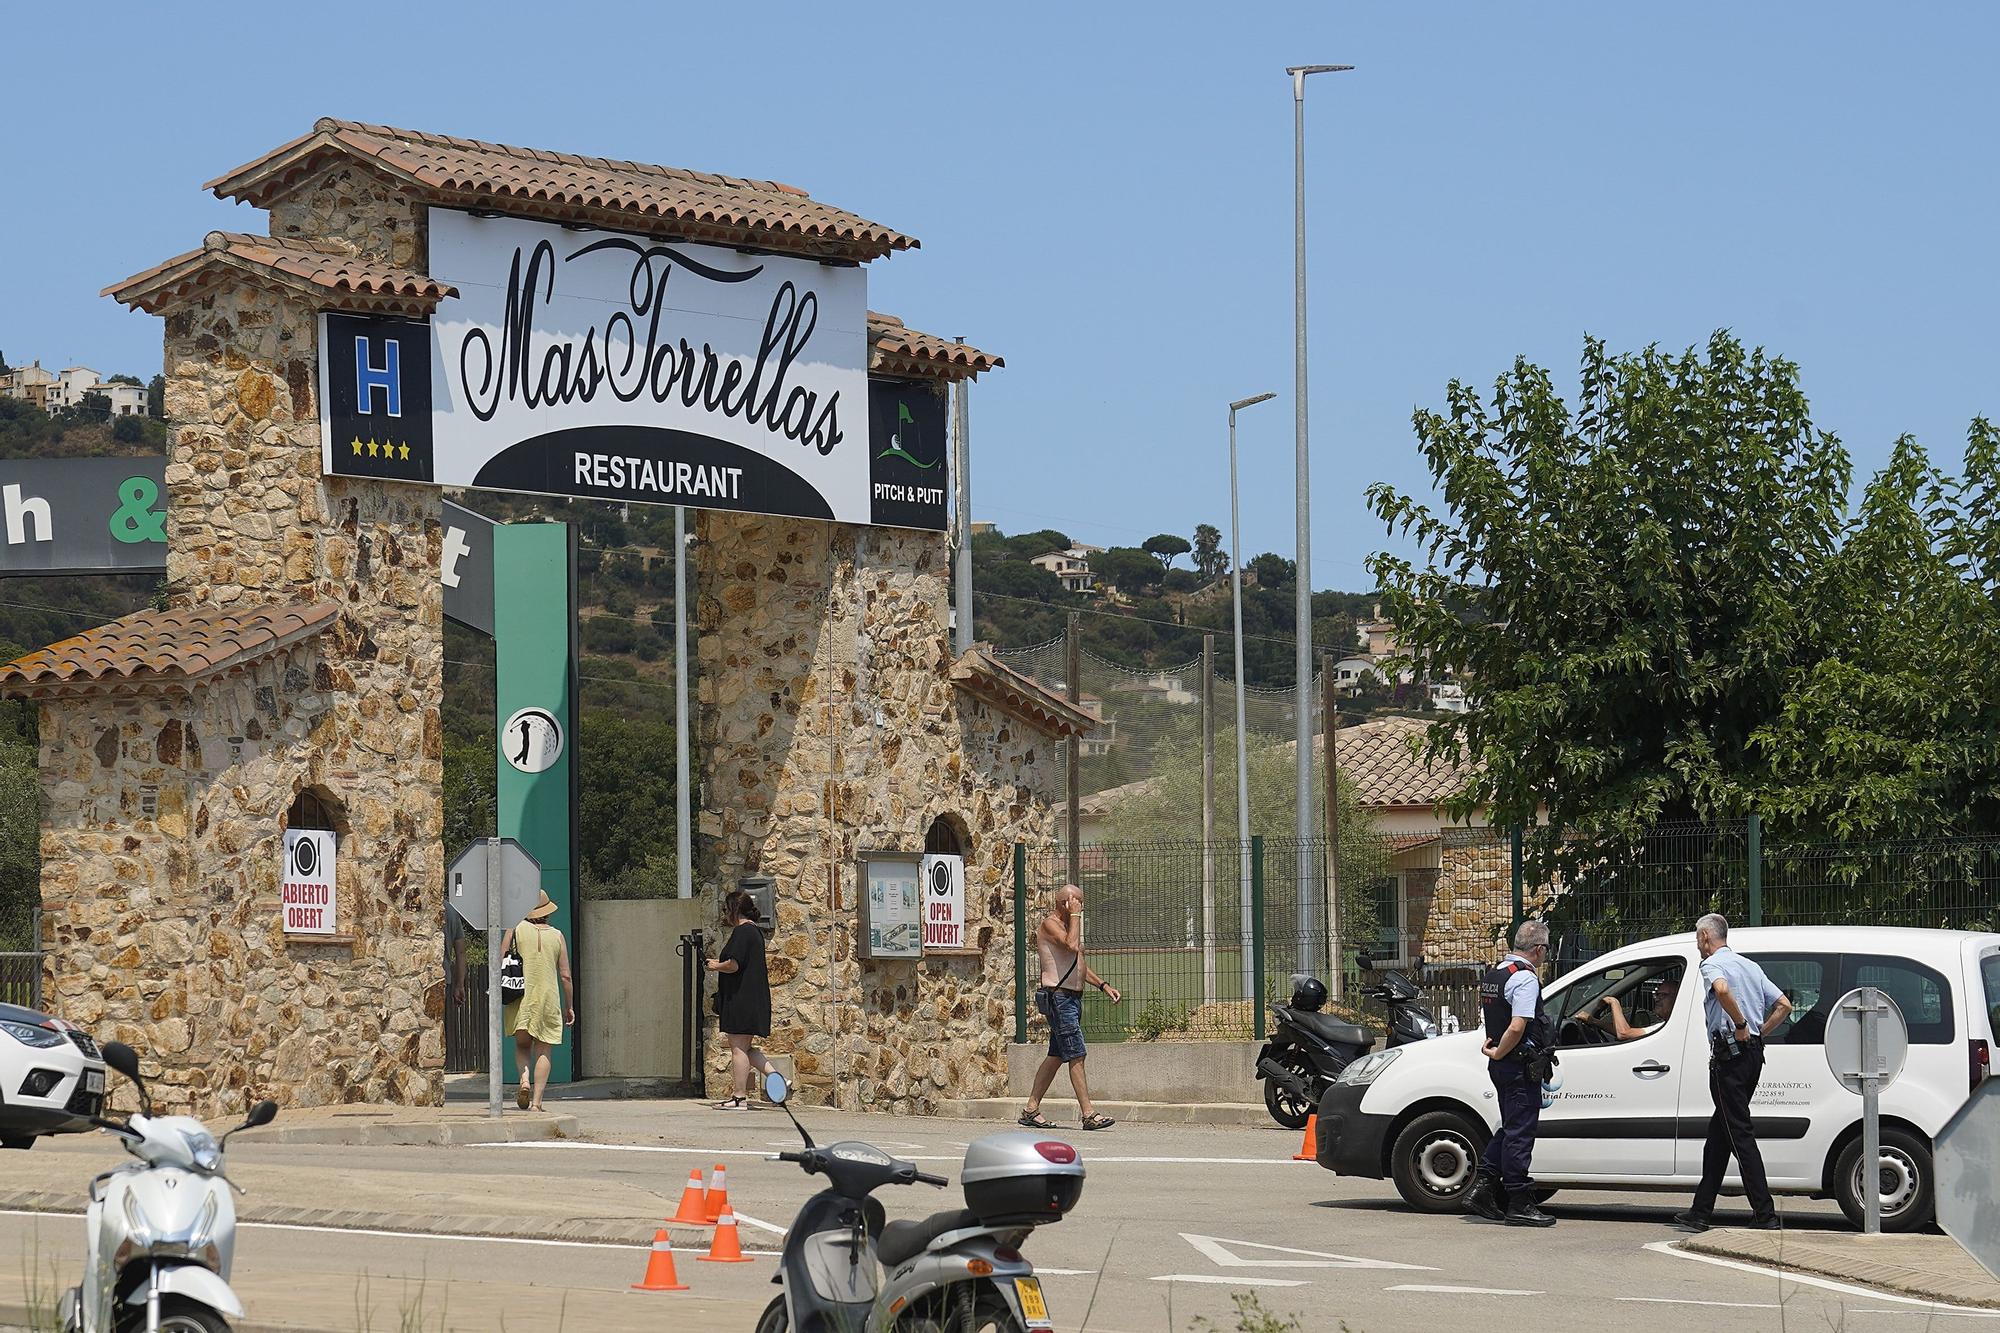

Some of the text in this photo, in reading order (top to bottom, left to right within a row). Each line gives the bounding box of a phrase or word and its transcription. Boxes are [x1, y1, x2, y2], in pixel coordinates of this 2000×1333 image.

[460, 238, 843, 456] Mas Torrellas
[355, 336, 401, 417] H
[574, 451, 743, 499] RESTAURANT
[874, 482, 943, 505] PITCH & PUTT
[282, 883, 328, 905] ABIERTO
[288, 907, 323, 928] OBERT
[930, 902, 952, 921] OPEN
[1541, 1092, 1562, 1100] Arial
[1565, 1092, 1603, 1100] Fomento
[1762, 1081, 1812, 1089] URBANÍSTICAS
